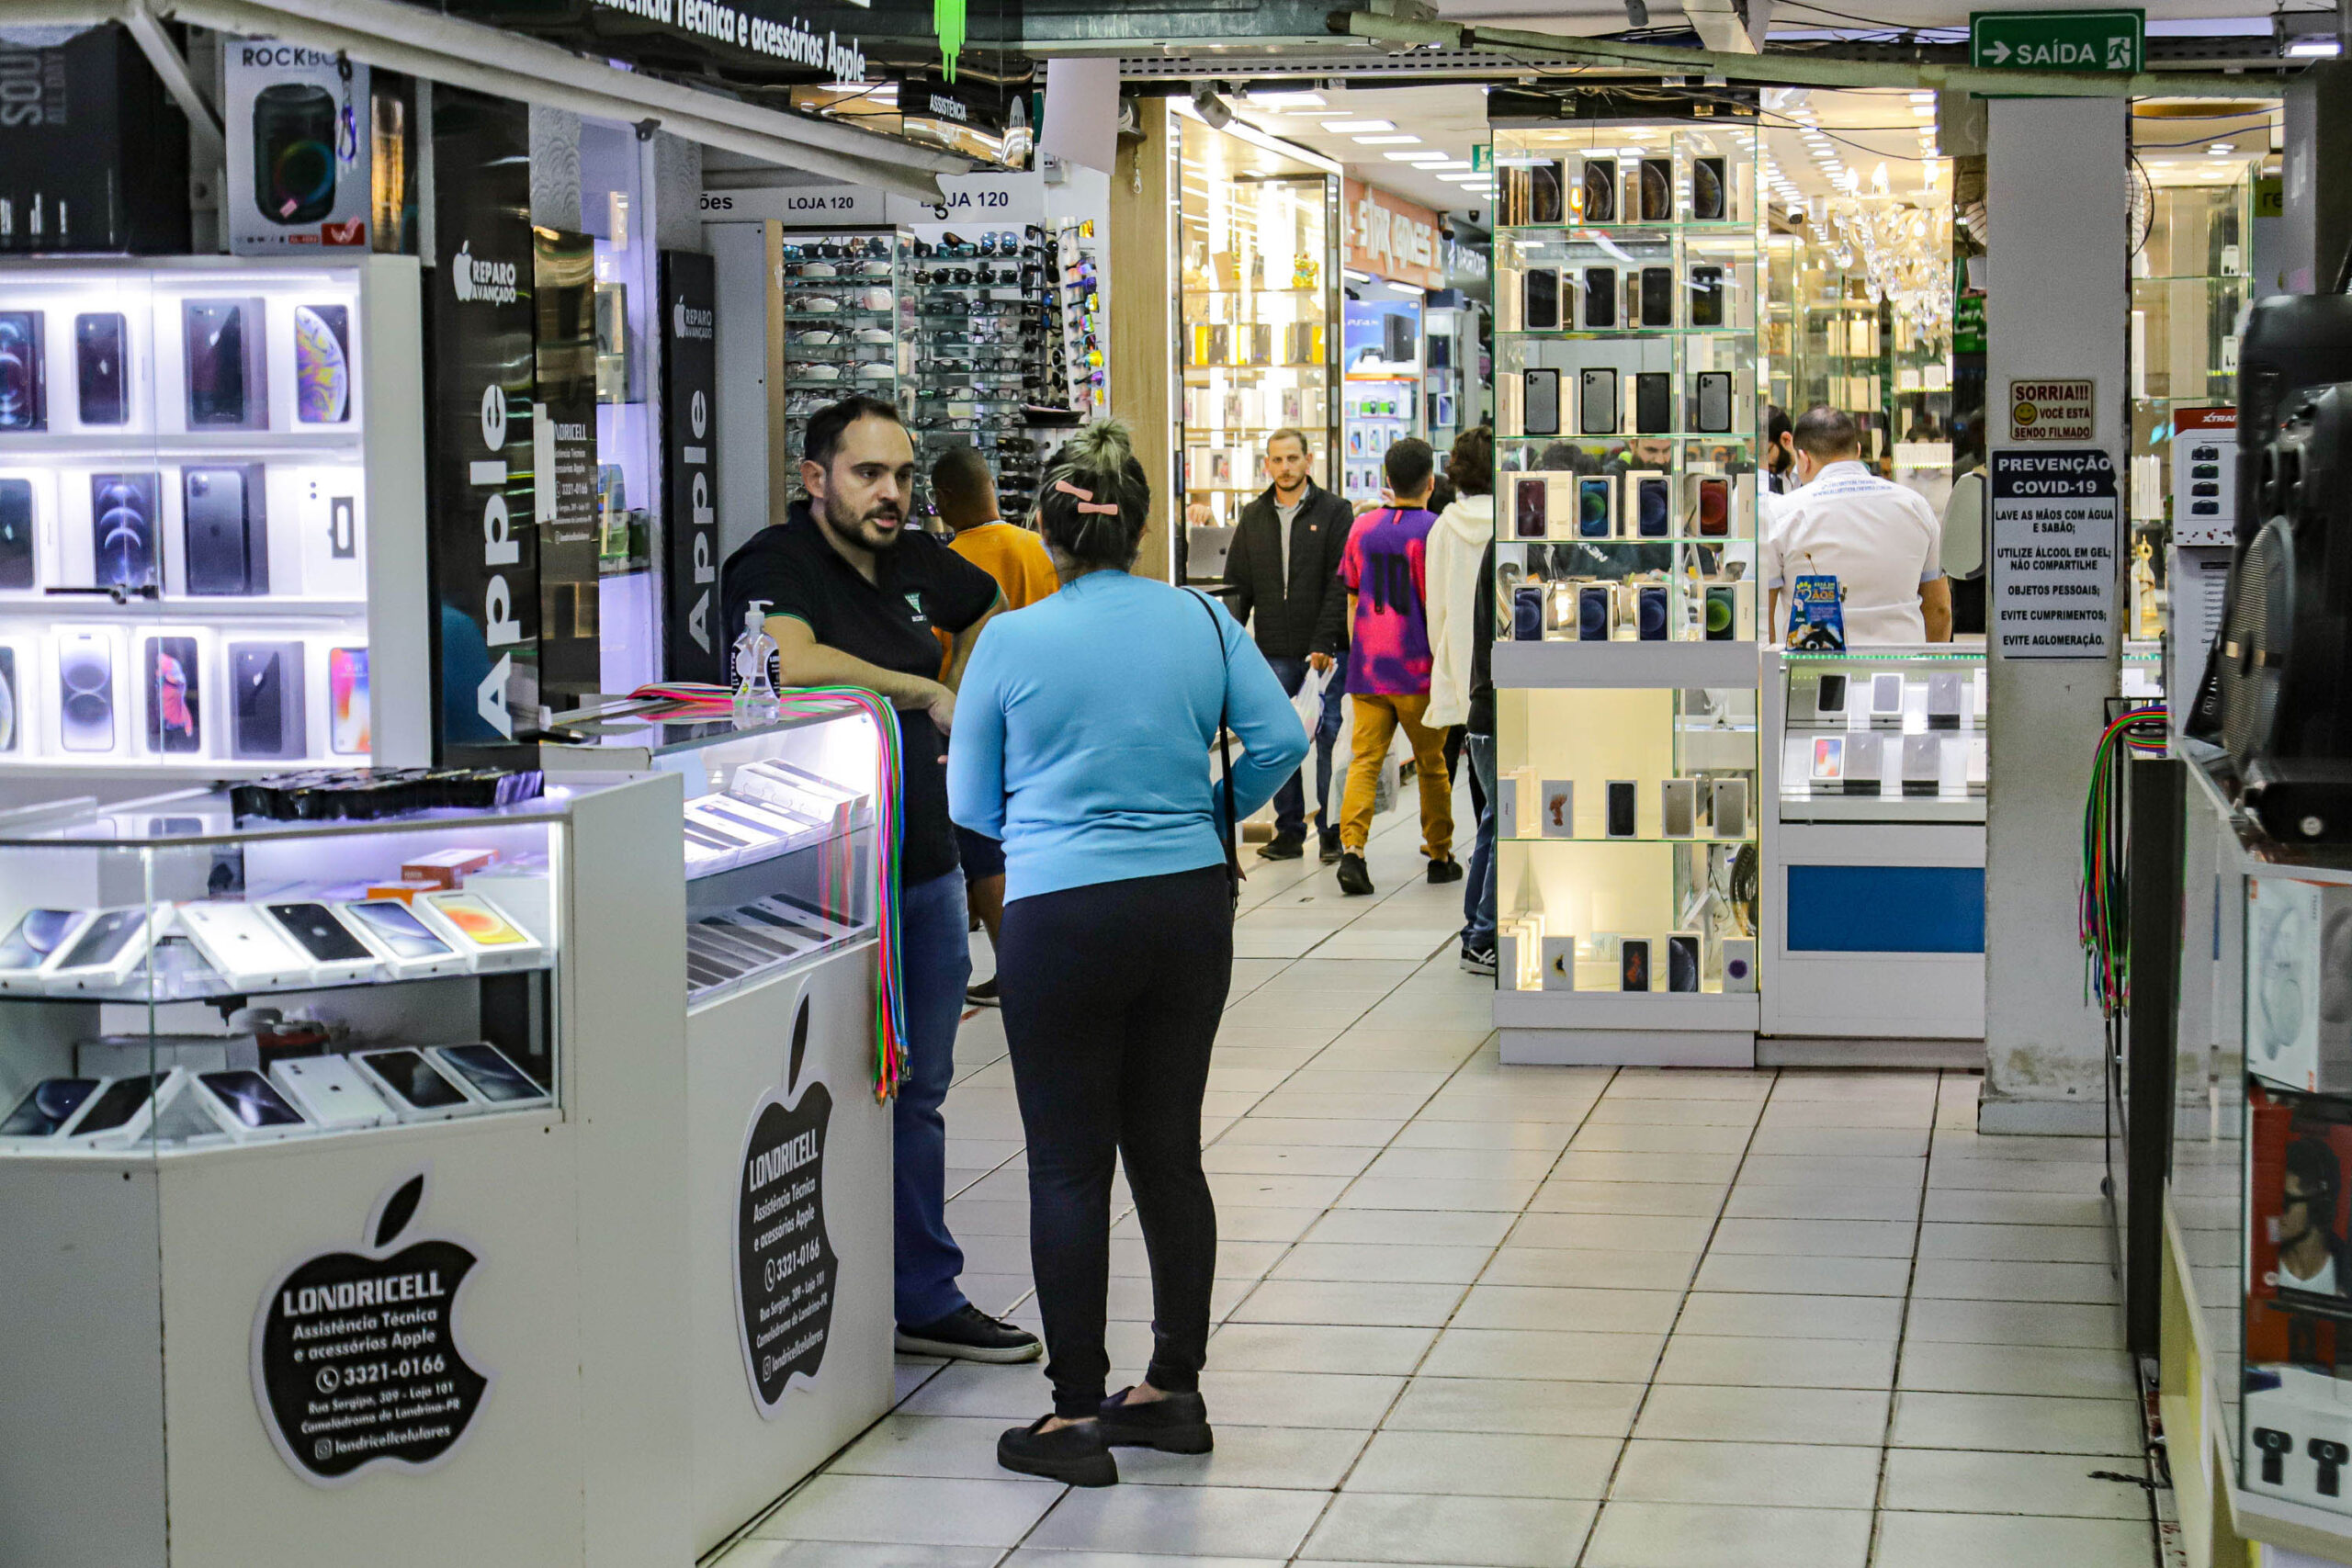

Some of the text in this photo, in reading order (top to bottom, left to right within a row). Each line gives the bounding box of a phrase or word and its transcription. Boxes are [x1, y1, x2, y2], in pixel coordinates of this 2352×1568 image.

[738, 13, 748, 48] e
[751, 16, 824, 69] acessórios
[827, 30, 866, 85] Apple
[2017, 39, 2097, 64] SAÍDA
[788, 197, 826, 209] LOJA
[831, 197, 854, 209] 120
[978, 191, 1009, 207] 120
[472, 260, 516, 287] REPARO
[471, 285, 516, 307] AVANÇADO
[685, 309, 712, 326] REPARO
[2015, 386, 2089, 401] SORRIA!!!
[2040, 406, 2090, 419] VOCÊ ESTÁ
[554, 423, 587, 441] NDRICELL
[2015, 427, 2090, 438] SENDO FILMADO
[1998, 456, 2111, 474] PREVENÇÃO
[2012, 480, 2098, 494] COVID-19
[684, 389, 716, 655] Apple
[1996, 507, 2113, 521] LAVE AS MÃOS COM ÁGUA
[2033, 521, 2075, 535] E SABÃO;
[469, 384, 521, 740] Apple
[1997, 546, 2111, 559] UTILIZE ÁLCOOL EM GEL;
[2010, 558, 2098, 570] NÃO COMPARTILHE
[2007, 585, 2100, 597] OBJETOS PESSOAIS;
[2001, 610, 2107, 622] EVITE CUMPRIMENTOS;
[2003, 633, 2105, 647] EVITE AGLOMERAÇÃO.
[750, 1129, 819, 1192] LONDRICELL
[753, 1177, 816, 1224] Assistência Técnica
[754, 1202, 815, 1252] e acessórios Apple
[776, 1235, 820, 1281] 3321-0166
[283, 1269, 446, 1317] LONDRICELL
[292, 1306, 438, 1341] Assistência Técnica
[294, 1328, 437, 1363] e acessórios Apple
[344, 1353, 446, 1387] 3321-0166
[309, 1401, 330, 1415] Rua
[379, 1389, 400, 1404] 309
[410, 1386, 433, 1401] Loja
[435, 1381, 455, 1396] 101
[379, 1408, 392, 1422] de
[395, 1398, 461, 1419] Londrina-PR
[335, 1426, 451, 1454] londricellcelulares
